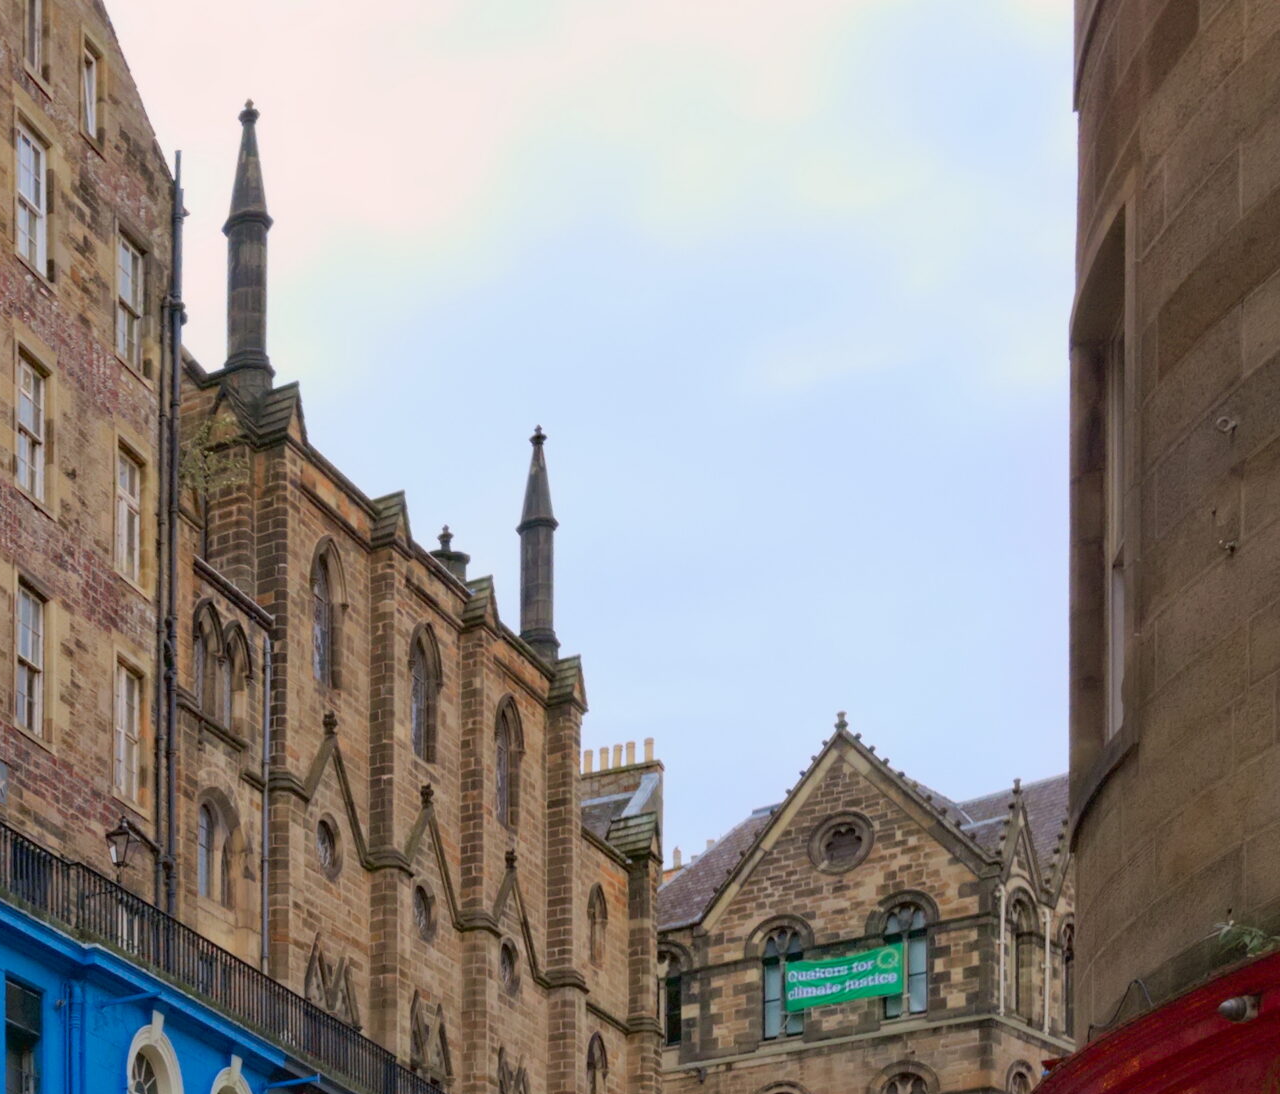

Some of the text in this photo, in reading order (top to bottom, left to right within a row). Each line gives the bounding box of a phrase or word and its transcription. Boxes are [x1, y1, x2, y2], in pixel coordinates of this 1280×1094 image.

[787, 965, 849, 983] Quakers
[851, 960, 876, 973] for
[787, 972, 898, 1001] climate justice
